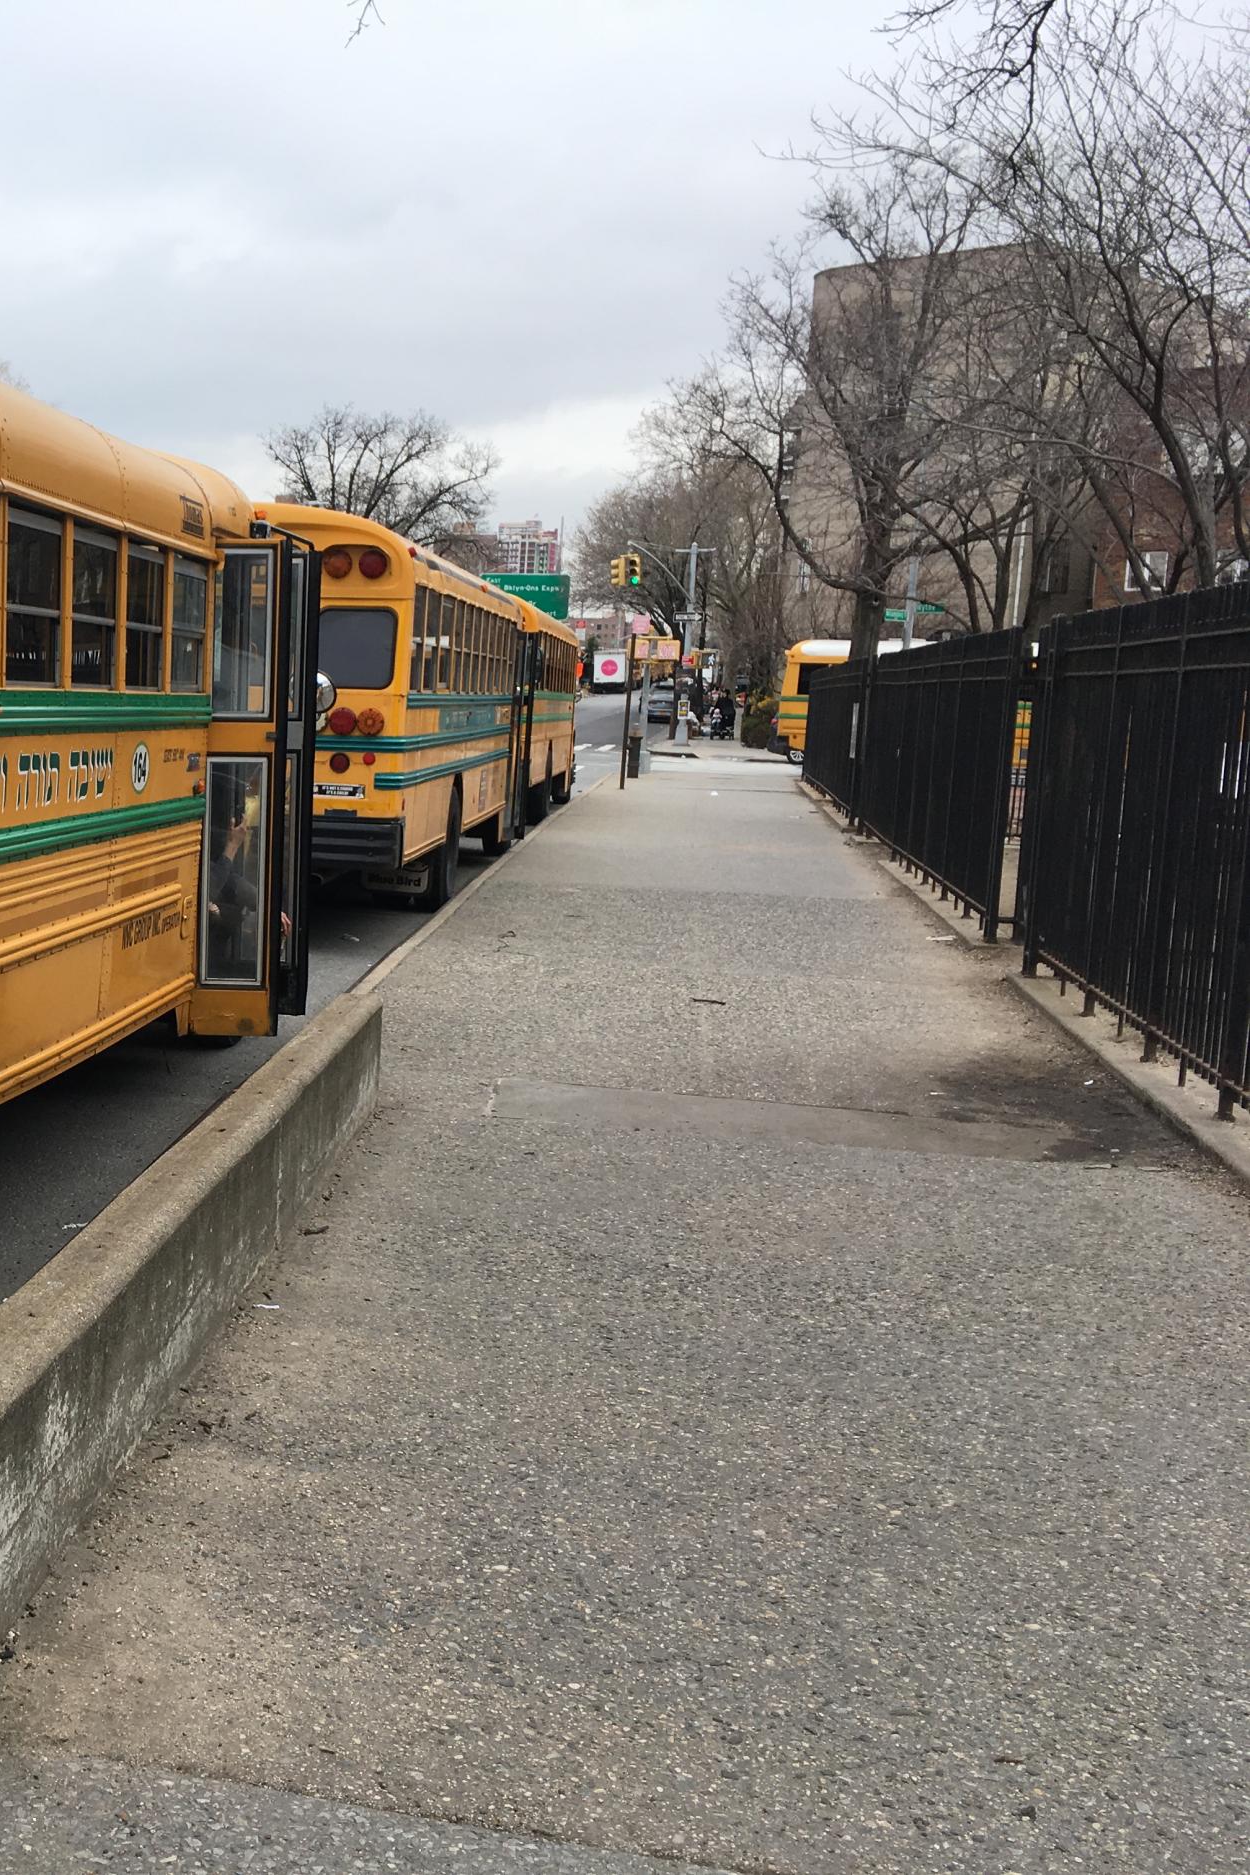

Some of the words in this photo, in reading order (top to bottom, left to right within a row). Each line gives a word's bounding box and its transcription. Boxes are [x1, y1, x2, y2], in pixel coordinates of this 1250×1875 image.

[16, 750, 60, 812] תורה
[67, 746, 114, 803] ישיבה
[133, 751, 147, 783] 164
[397, 875, 421, 887] Bird
